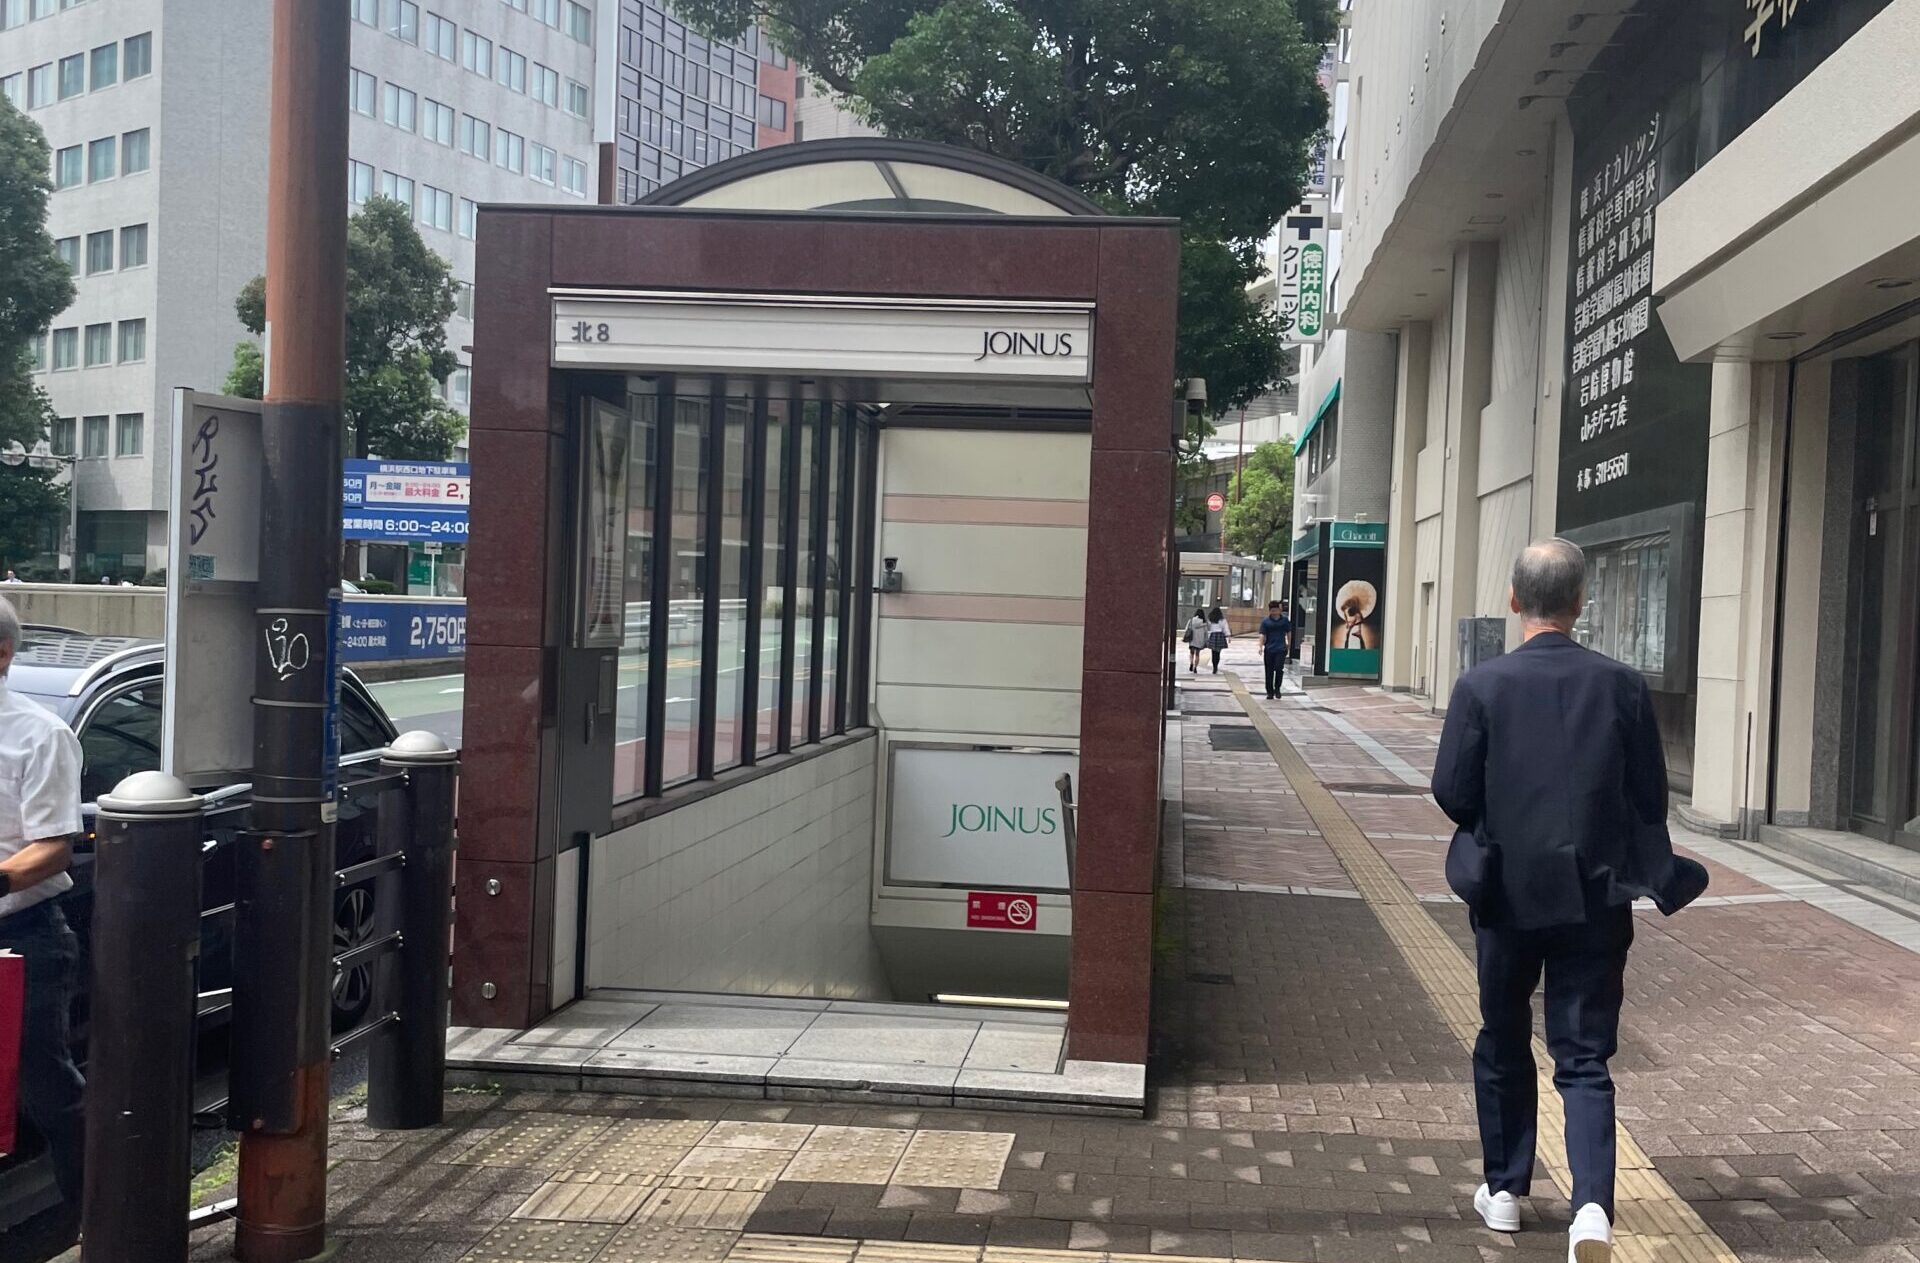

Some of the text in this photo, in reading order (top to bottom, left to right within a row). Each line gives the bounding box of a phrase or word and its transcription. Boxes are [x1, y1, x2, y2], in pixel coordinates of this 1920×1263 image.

[1578, 158, 1657, 258] 情報科学専門学校
[1576, 204, 1654, 298] 情報科学研究所
[1300, 250, 1323, 330] 徳井内科
[571, 321, 610, 343] 北8
[974, 331, 1072, 361] JOINUS
[940, 803, 1056, 838] JOINUS
